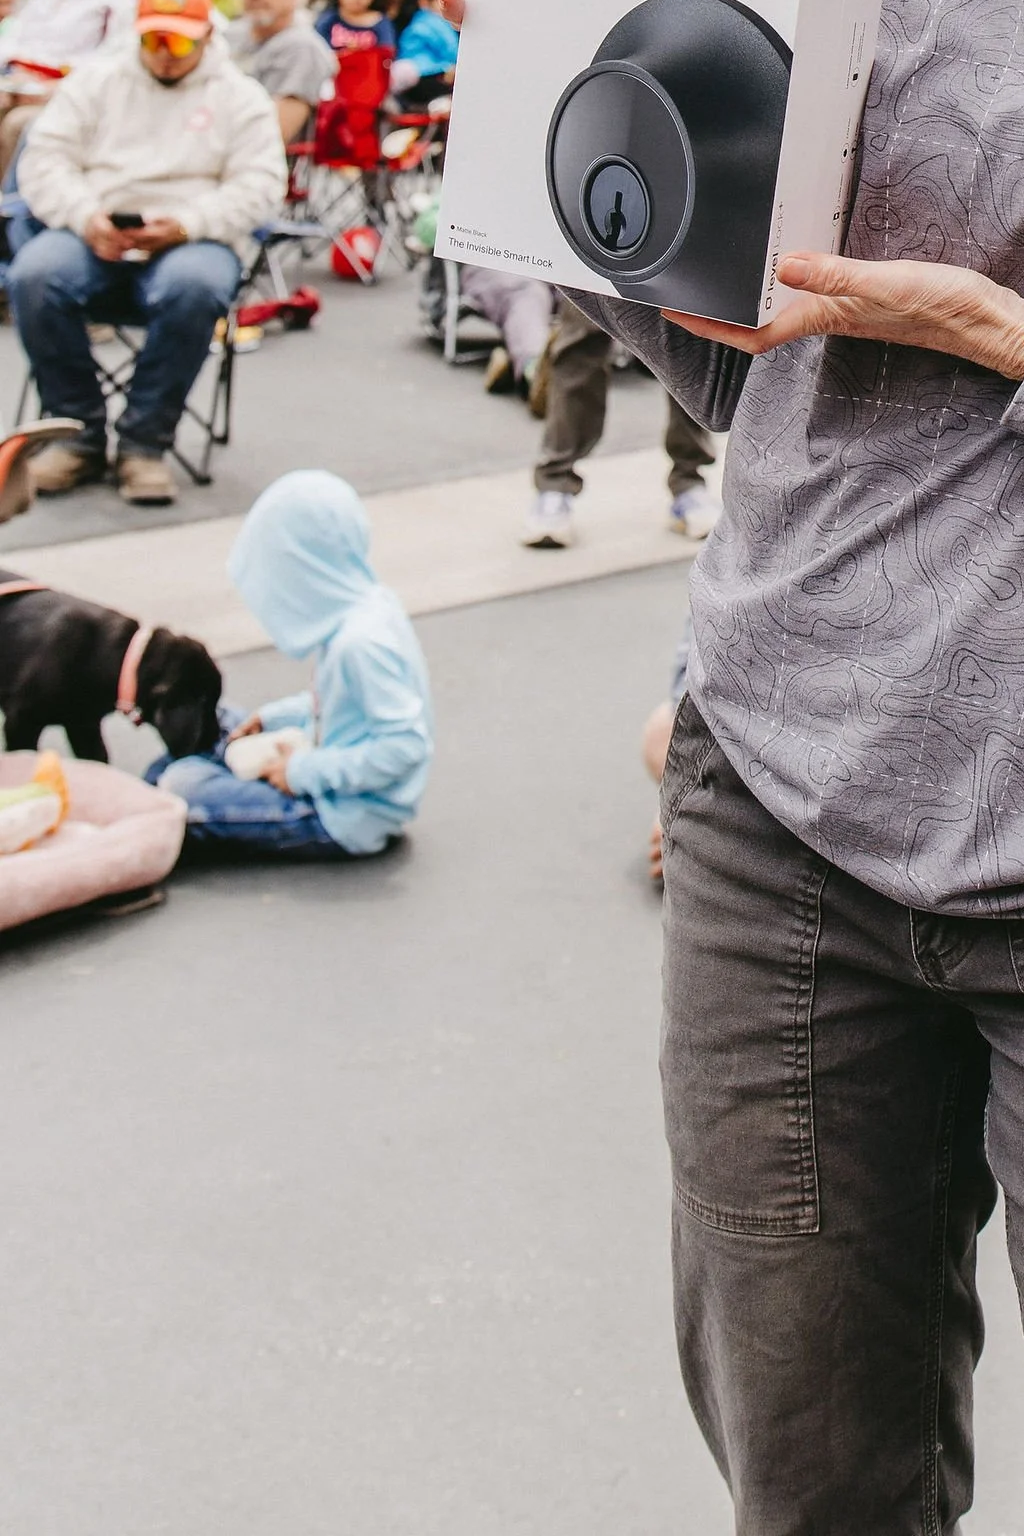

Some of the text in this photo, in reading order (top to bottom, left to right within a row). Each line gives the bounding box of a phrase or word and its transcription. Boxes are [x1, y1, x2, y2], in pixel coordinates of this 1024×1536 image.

[472, 229, 488, 238] Black
[448, 237, 553, 269] The Invisible Smart Lock
[767, 252, 779, 292] level
